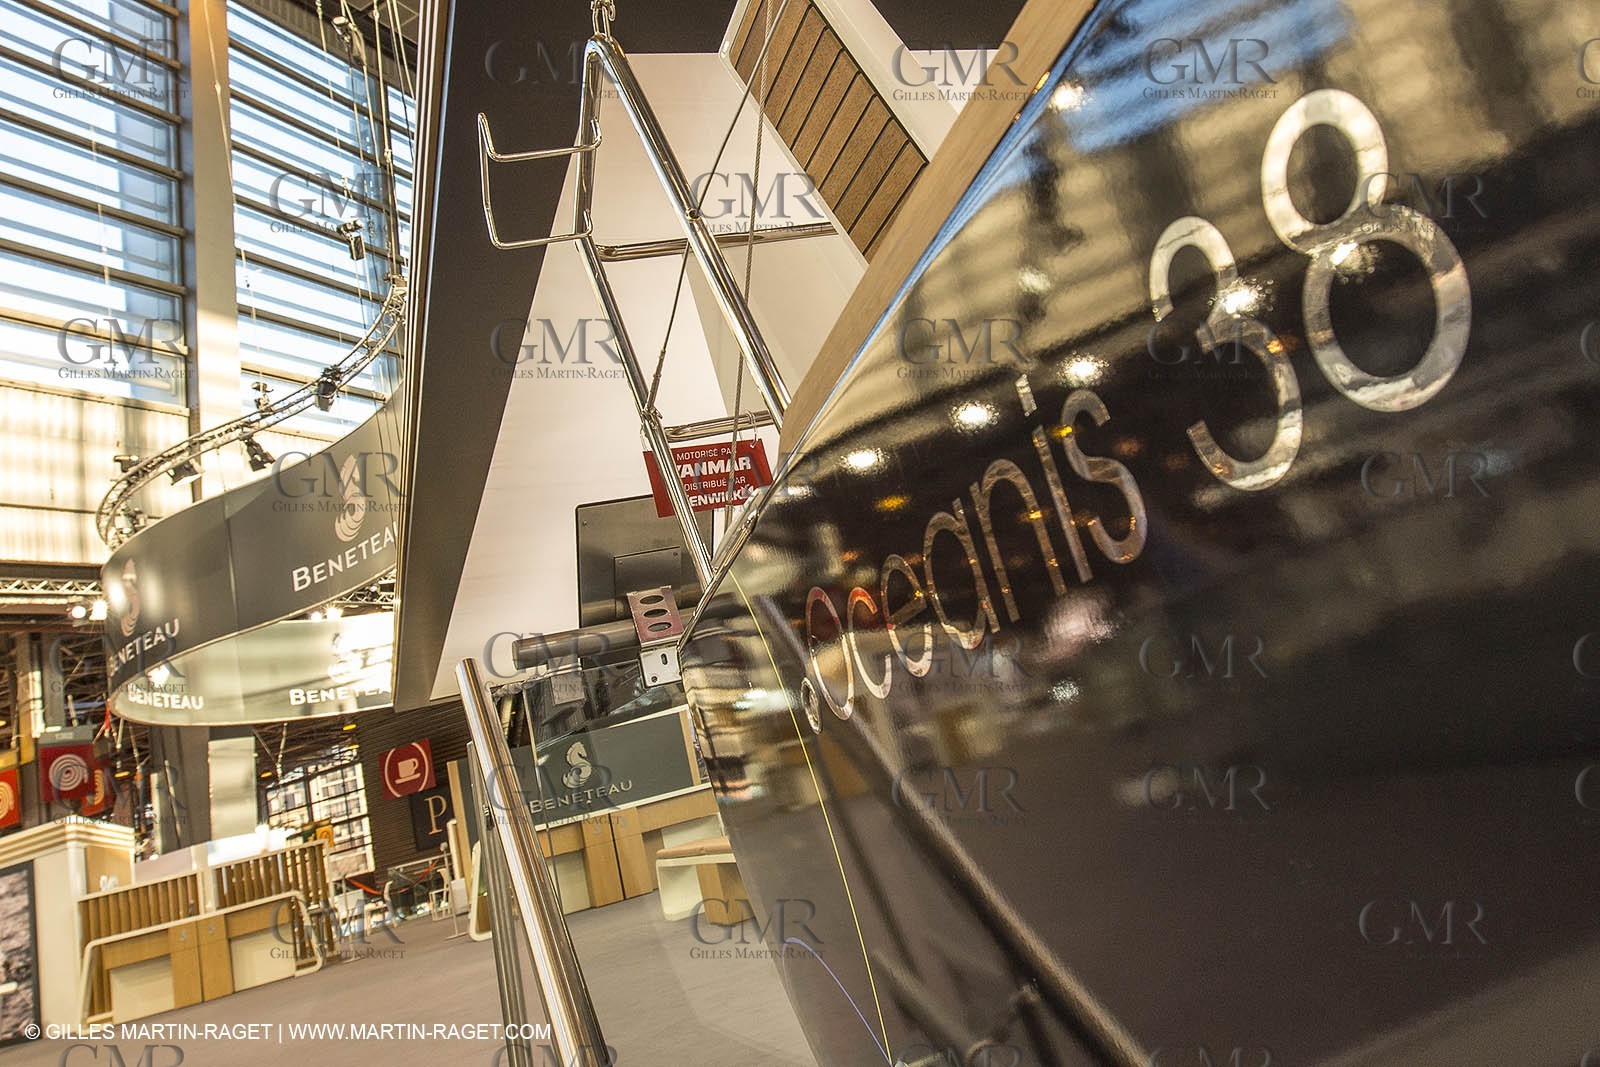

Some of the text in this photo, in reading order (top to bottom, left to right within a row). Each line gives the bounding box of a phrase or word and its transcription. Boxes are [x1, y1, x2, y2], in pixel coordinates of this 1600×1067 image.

[806, 88, 1472, 721] oceanis 38
[687, 488, 743, 507] ENWIK
[424, 795, 448, 835] P
[529, 779, 633, 814] BENETEAU
